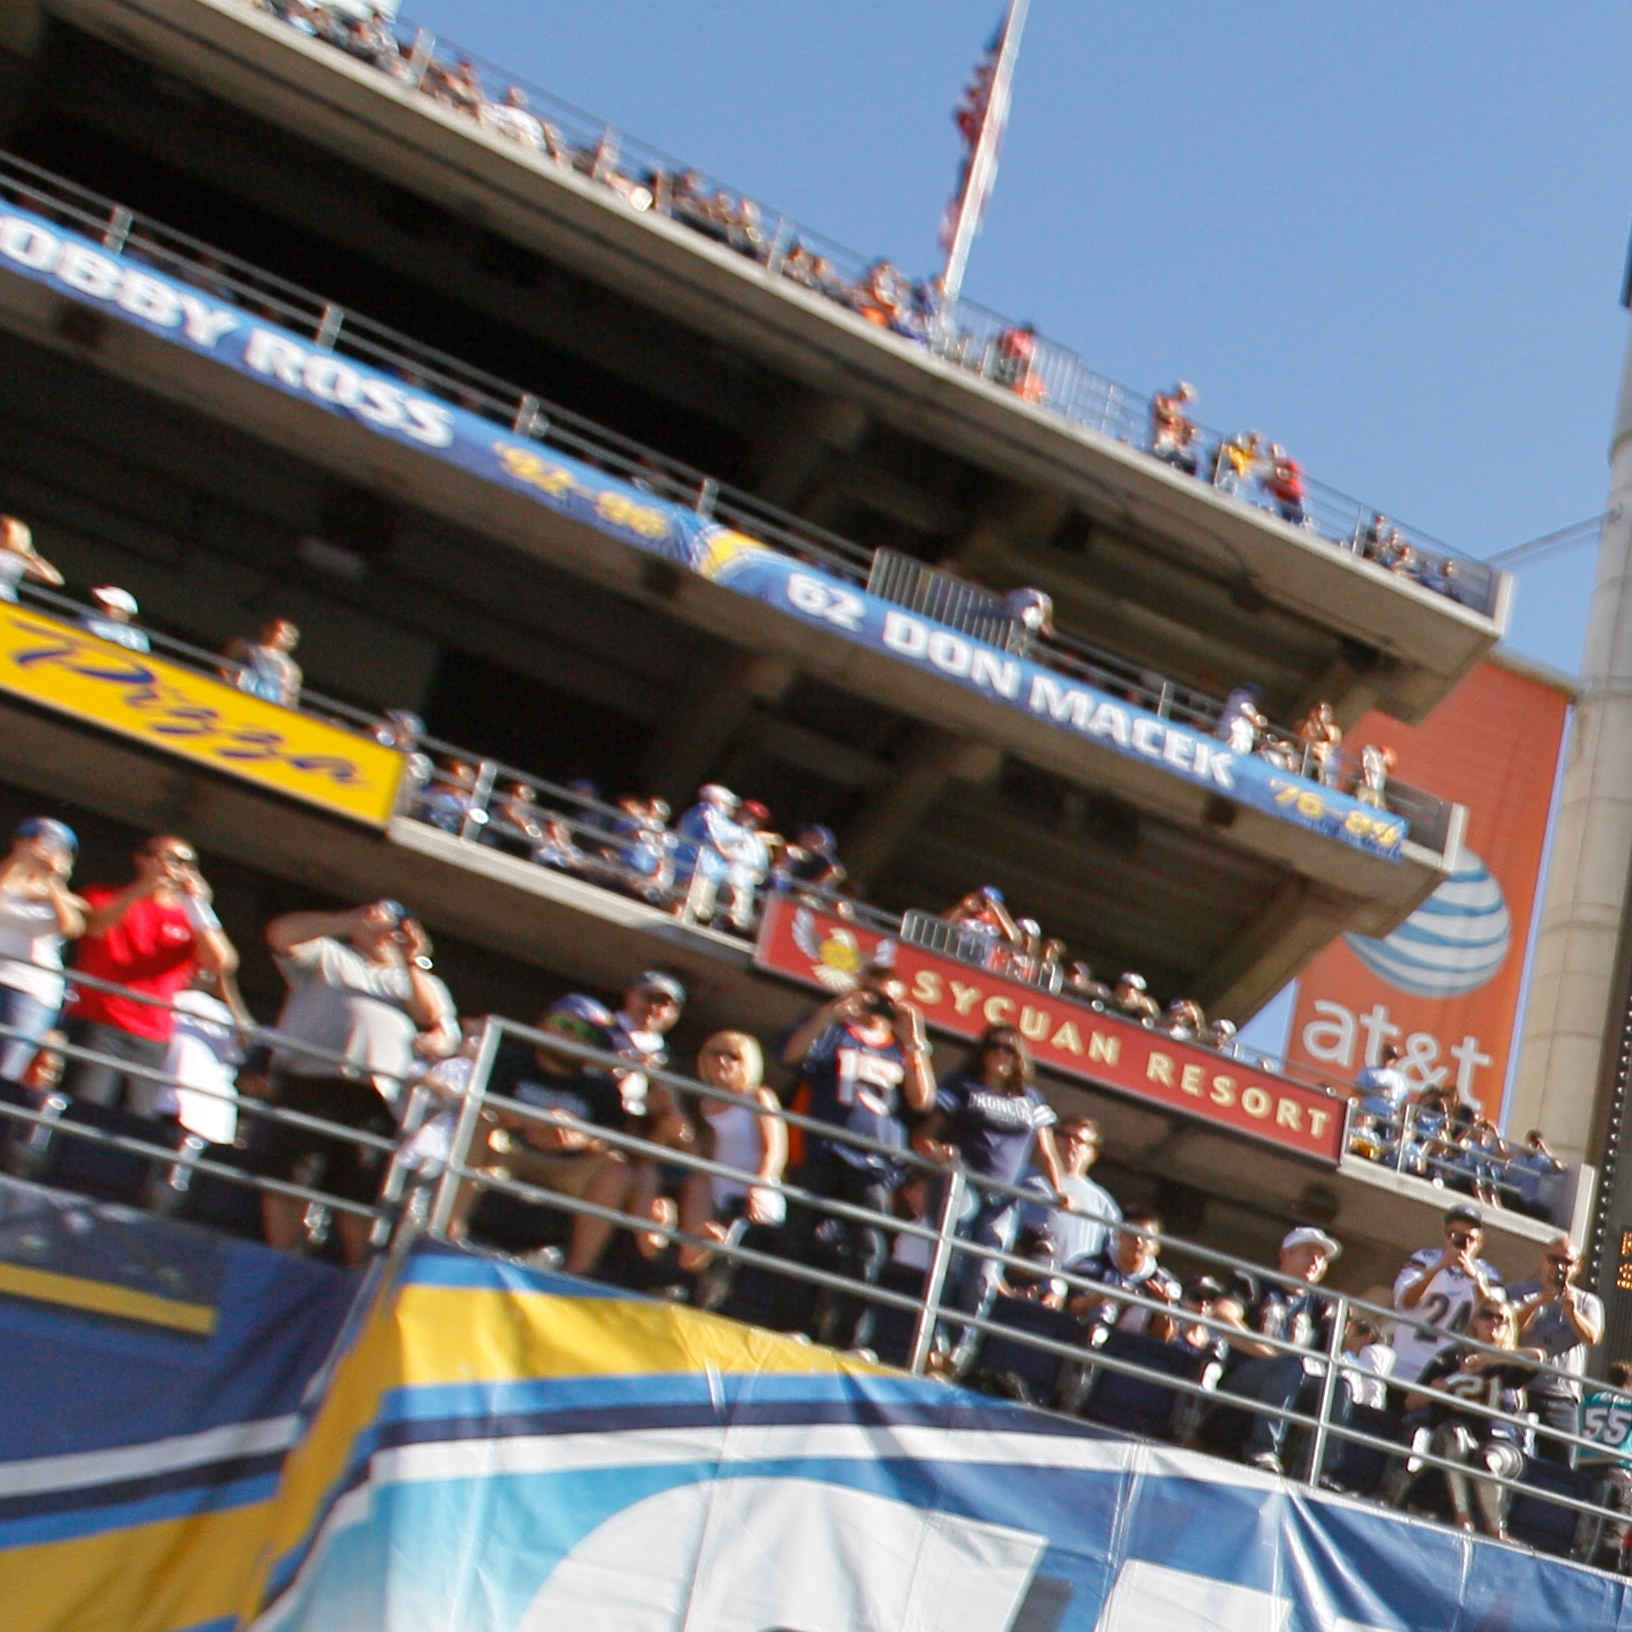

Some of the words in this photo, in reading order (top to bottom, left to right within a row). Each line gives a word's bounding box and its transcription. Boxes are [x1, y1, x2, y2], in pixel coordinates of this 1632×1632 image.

[244, 327, 454, 448] ROSS
[8, 618, 375, 790] Pizza
[787, 572, 866, 632] 62
[882, 609, 1021, 699] DON
[1029, 675, 1237, 788] MACEK
[837, 1048, 905, 1115] 15
[910, 968, 1122, 1068] SYCUAN
[1146, 1052, 1334, 1140] RESORT
[1302, 998, 1496, 1110] at&t
